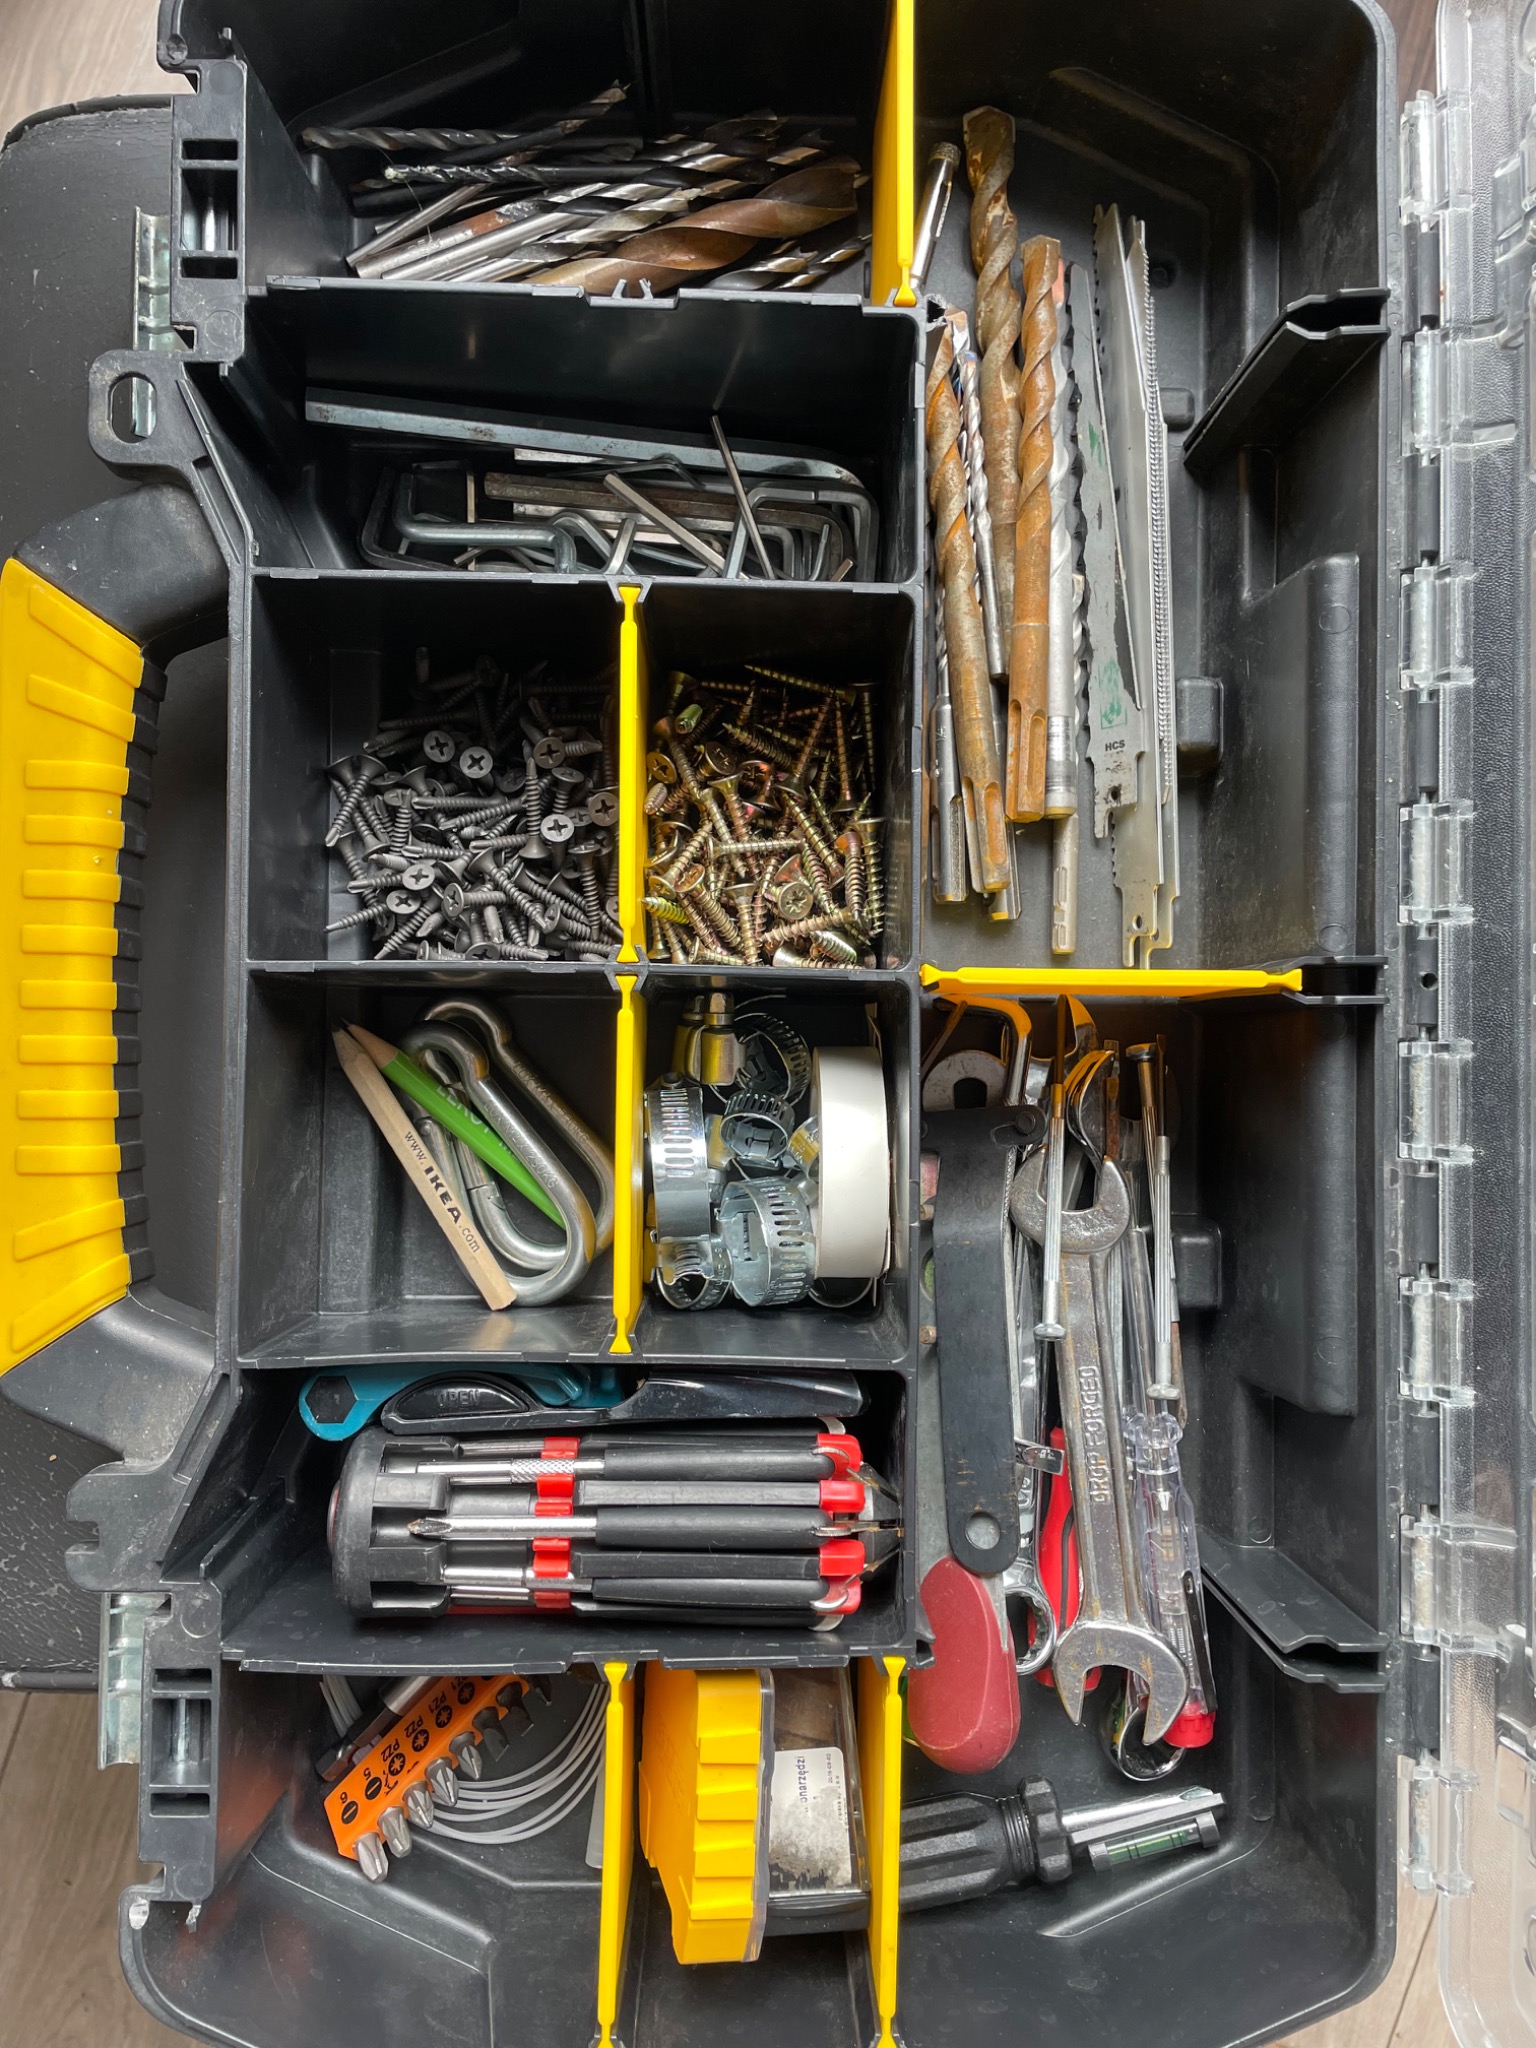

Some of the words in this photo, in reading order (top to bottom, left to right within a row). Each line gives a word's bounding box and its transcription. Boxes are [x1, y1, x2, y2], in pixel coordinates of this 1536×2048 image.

[1105, 740, 1125, 752] HCS
[405, 1131, 480, 1253] www.IKEA.com
[1079, 1365, 1105, 1449] FORGED
[1086, 1450, 1110, 1505] DROP
[429, 1692, 446, 1714] PZ1
[404, 1714, 424, 1738] PZ2
[381, 1738, 400, 1763] PZ2
[363, 1767, 371, 1780] 5
[339, 1791, 348, 1804] 6
